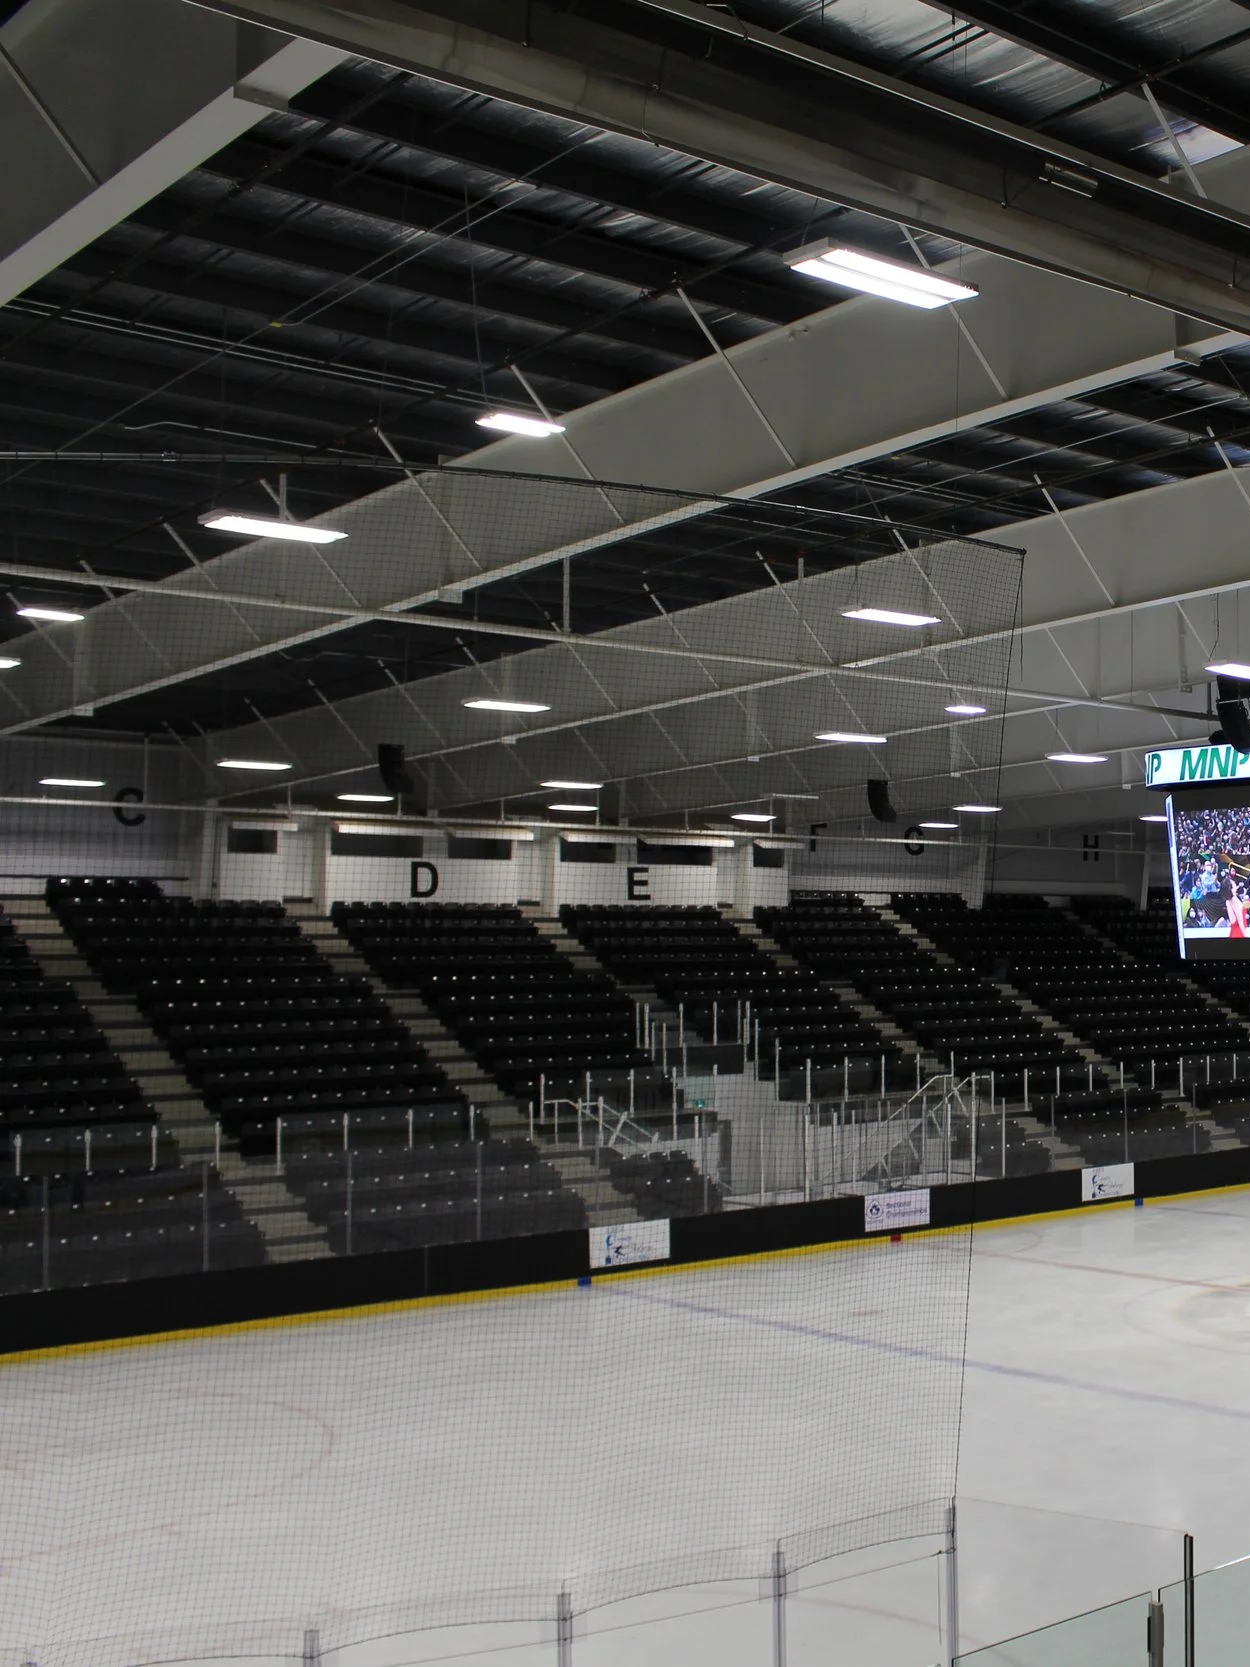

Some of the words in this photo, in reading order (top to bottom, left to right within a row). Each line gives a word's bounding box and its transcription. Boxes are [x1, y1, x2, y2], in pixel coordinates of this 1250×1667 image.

[112, 787, 146, 826] C
[904, 826, 924, 855] G
[1083, 834, 1098, 861] H
[411, 862, 439, 897] D
[627, 867, 651, 900] E
